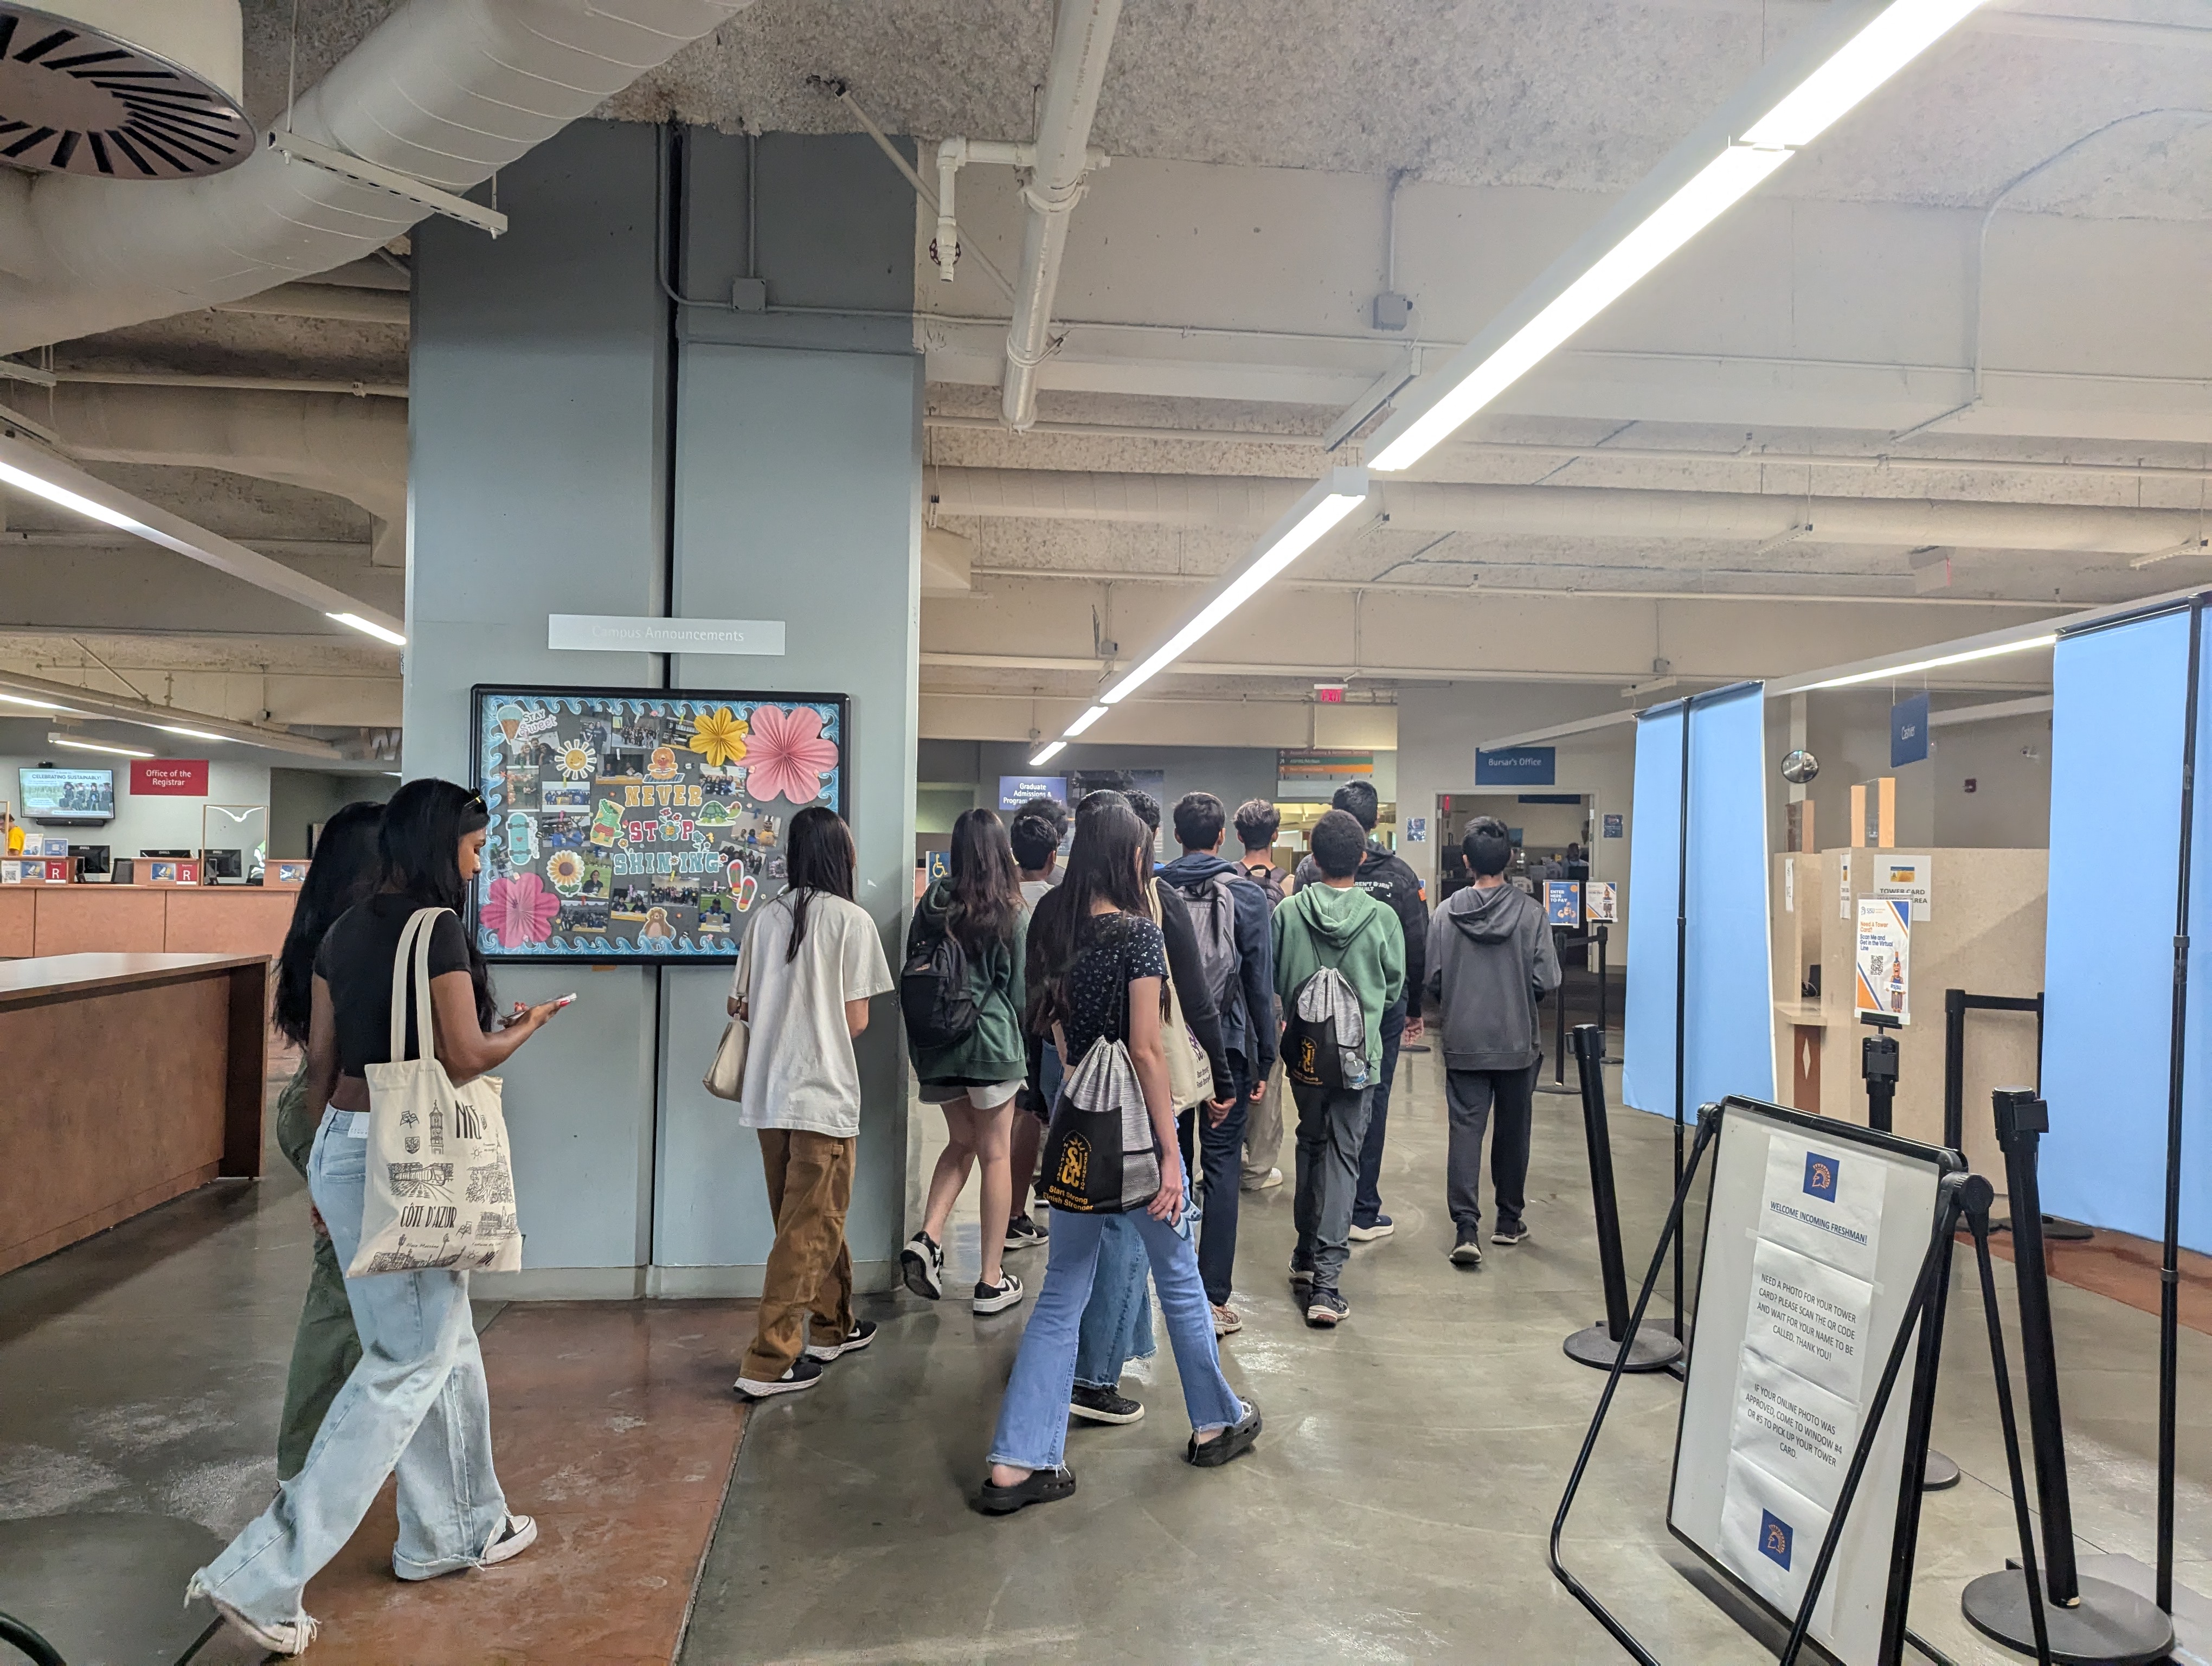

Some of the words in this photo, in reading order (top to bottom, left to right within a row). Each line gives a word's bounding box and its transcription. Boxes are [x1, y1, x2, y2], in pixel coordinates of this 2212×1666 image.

[592, 626, 641, 639] Campus
[645, 626, 744, 641] Announcements
[1322, 689, 1342, 702] EXIT
[520, 715, 557, 735] Sweet
[523, 710, 545, 722] STAY
[1519, 758, 1541, 766] Office
[146, 769, 168, 777] Office
[152, 778, 185, 787] Registrar
[626, 786, 702, 806] NEVER
[1003, 797, 1028, 805] Program
[52, 868, 60, 879] R
[183, 870, 190, 880] R
[1043, 1191, 1063, 1204] Finish
[1064, 1199, 1094, 1211] Stronger
[1049, 1185, 1065, 1196] Start
[1066, 1191, 1088, 1204] Strong
[400, 1202, 425, 1228] CÔTE
[425, 1206, 457, 1228] D'AZUR
[1770, 1201, 1798, 1218] WELCOME
[1799, 1211, 1829, 1229] INCOMING
[1831, 1223, 1868, 1244] FRESHMAN!
[1761, 1273, 1776, 1286] NEED
[1777, 1280, 1781, 1290] A
[1782, 1283, 1803, 1298] PHOTO
[1803, 1292, 1815, 1305] FOR
[1816, 1298, 1832, 1312] YOUR
[1834, 1305, 1856, 1324] TOWER
[1759, 1287, 1777, 1303] CARD?
[1778, 1296, 1798, 1312] PLEASE
[1799, 1306, 1814, 1320] SCAN
[1815, 1313, 1826, 1327] THE
[1827, 1319, 1836, 1331] QR
[1837, 1325, 1855, 1340] CODE
[1757, 1302, 1770, 1314] AND
[1771, 1308, 1786, 1322] WAIT
[1786, 1315, 1798, 1328] FOR
[1799, 1321, 1815, 1337] YOUR
[1816, 1330, 1834, 1347] NAME
[1835, 1339, 1844, 1350] TO
[1845, 1345, 1854, 1356] BE
[1773, 1325, 1795, 1343] CALLED.
[1796, 1336, 1815, 1353] THANK
[1816, 1346, 1832, 1361] YOU!
[1754, 1383, 1760, 1392] IF
[1760, 1386, 1776, 1402] YOUR
[1777, 1396, 1797, 1414] ONLINE
[1798, 1407, 1819, 1426] PHOTO
[1821, 1419, 1835, 1435] WAS
[1746, 1393, 1776, 1418] APPROVED,
[1776, 1411, 1794, 1427] COME
[1795, 1420, 1803, 1432] TO
[1804, 1426, 1834, 1449] WINDOW
[1834, 1443, 1842, 1454] #4
[1747, 1408, 1756, 1419] OR
[1756, 1414, 1763, 1424] #5
[1764, 1418, 1772, 1429] TO
[1772, 1423, 1785, 1438] PICK
[1786, 1431, 1795, 1442] UP
[1796, 1436, 1812, 1453] YOUR
[1814, 1446, 1836, 1467] TOWER
[1779, 1442, 1797, 1459] CARD.
